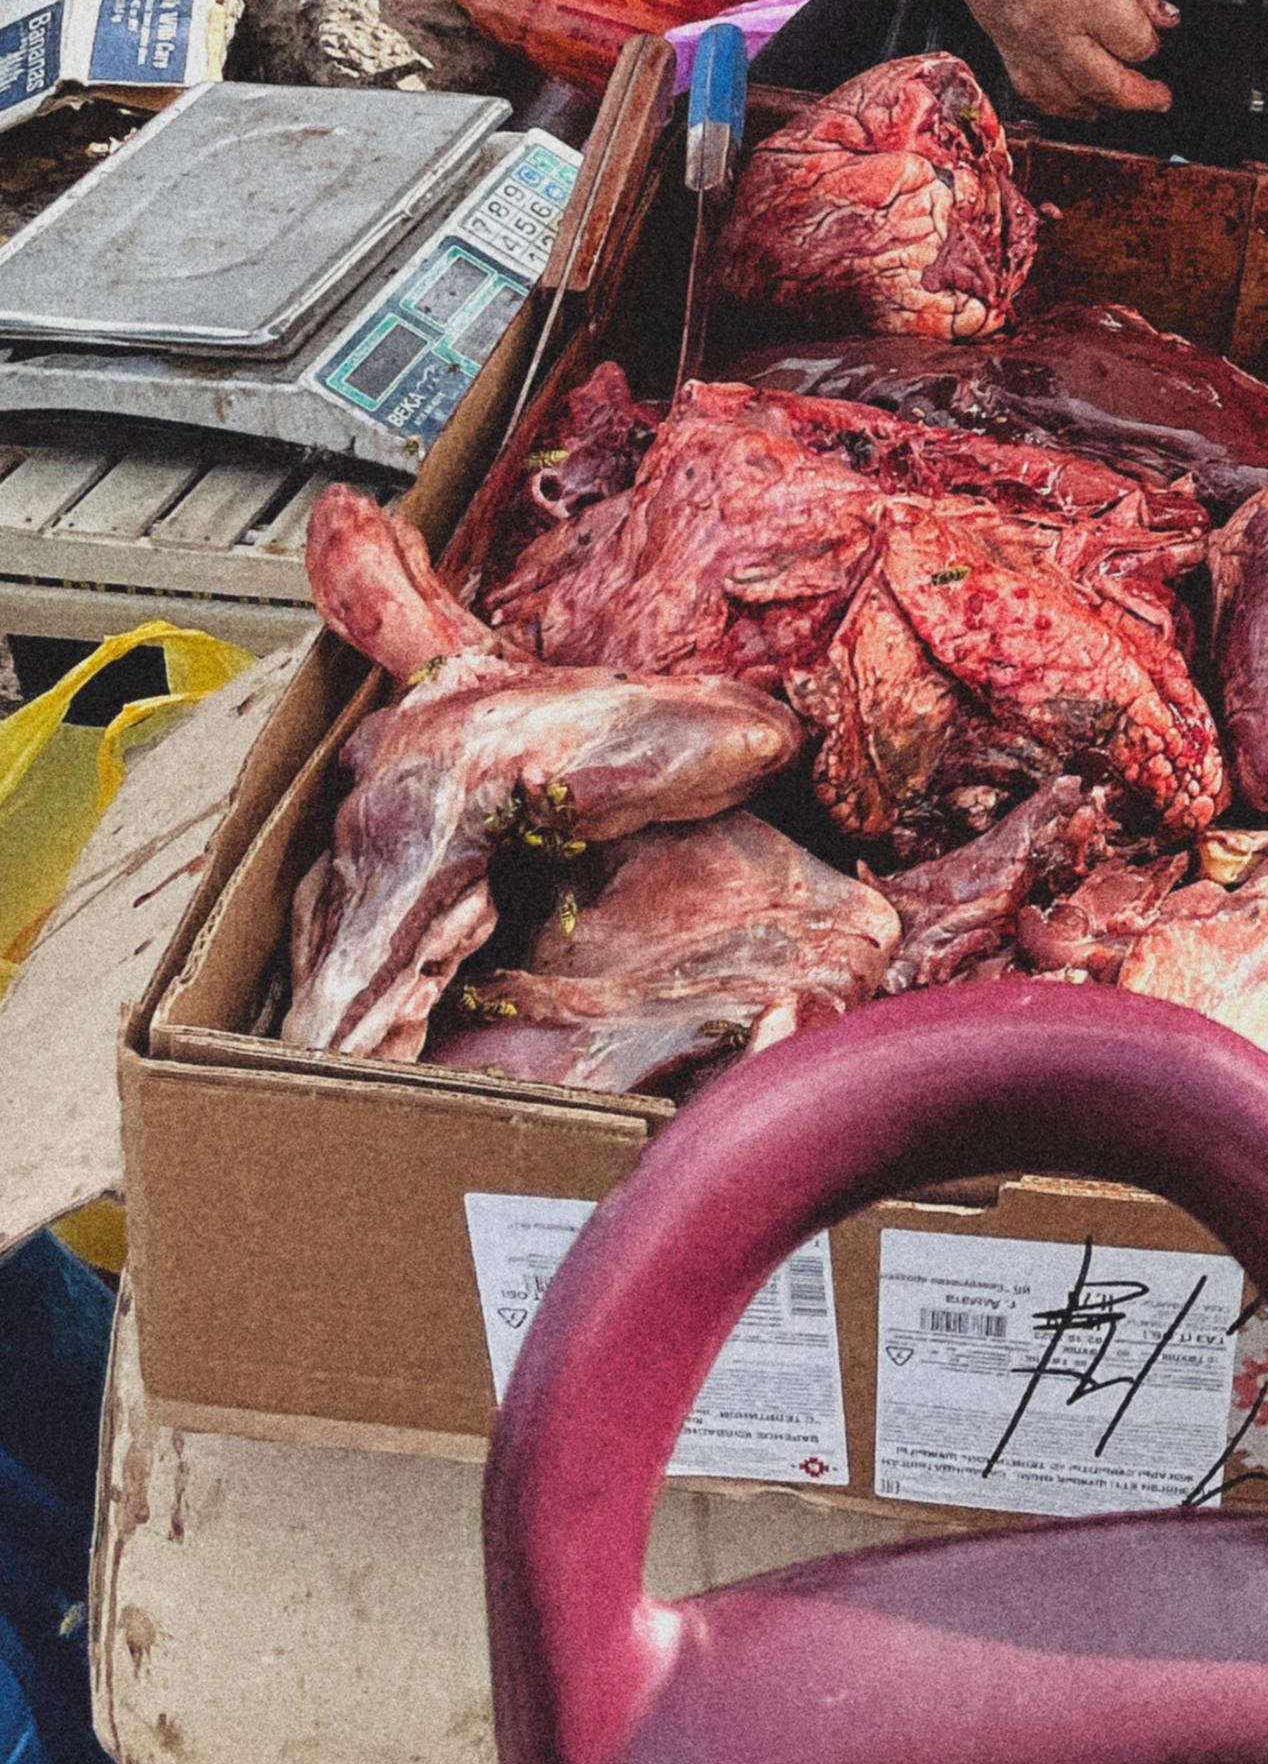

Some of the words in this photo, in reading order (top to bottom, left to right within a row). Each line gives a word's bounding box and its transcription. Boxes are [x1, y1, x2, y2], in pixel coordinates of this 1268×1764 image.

[26, 11, 52, 93] Bananas
[488, 202, 510, 218] 8
[504, 184, 525, 203] 9
[504, 235, 522, 253] 4
[515, 218, 536, 236] 5
[531, 201, 552, 218] 6
[387, 388, 427, 428] BEKA
